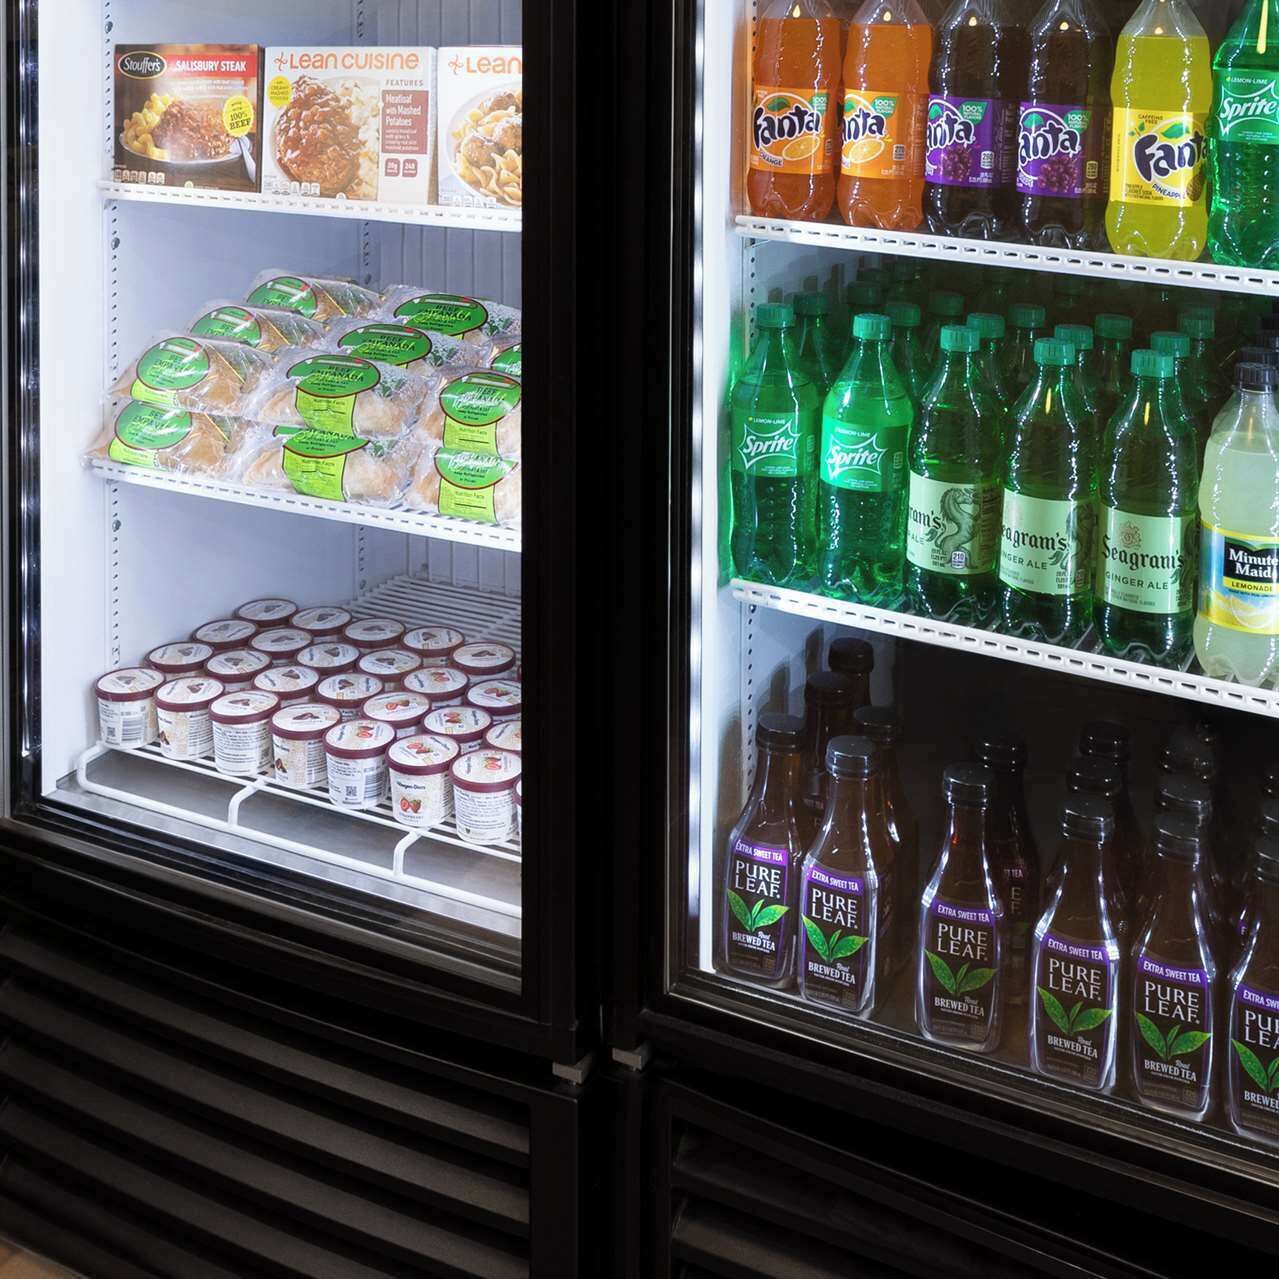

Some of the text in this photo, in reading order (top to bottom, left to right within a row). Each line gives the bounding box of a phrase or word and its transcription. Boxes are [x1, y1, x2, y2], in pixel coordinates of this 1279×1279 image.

[123, 57, 160, 73] Stouffer's
[176, 61, 246, 71] SALISBURY STEAK
[1220, 96, 1278, 121] Sprite
[744, 434, 793, 456] Sprite
[826, 446, 878, 467] Sprite
[1102, 536, 1186, 571] Seagram's
[1229, 548, 1279, 568] Minute
[1105, 570, 1169, 590] GINGER ALE
[1234, 562, 1277, 578] Maid
[1231, 581, 1273, 593] LEMONADE
[812, 870, 859, 891] EXTRA SWEET TEA
[812, 888, 857, 914] PURE
[808, 962, 856, 984] BREWED TEA
